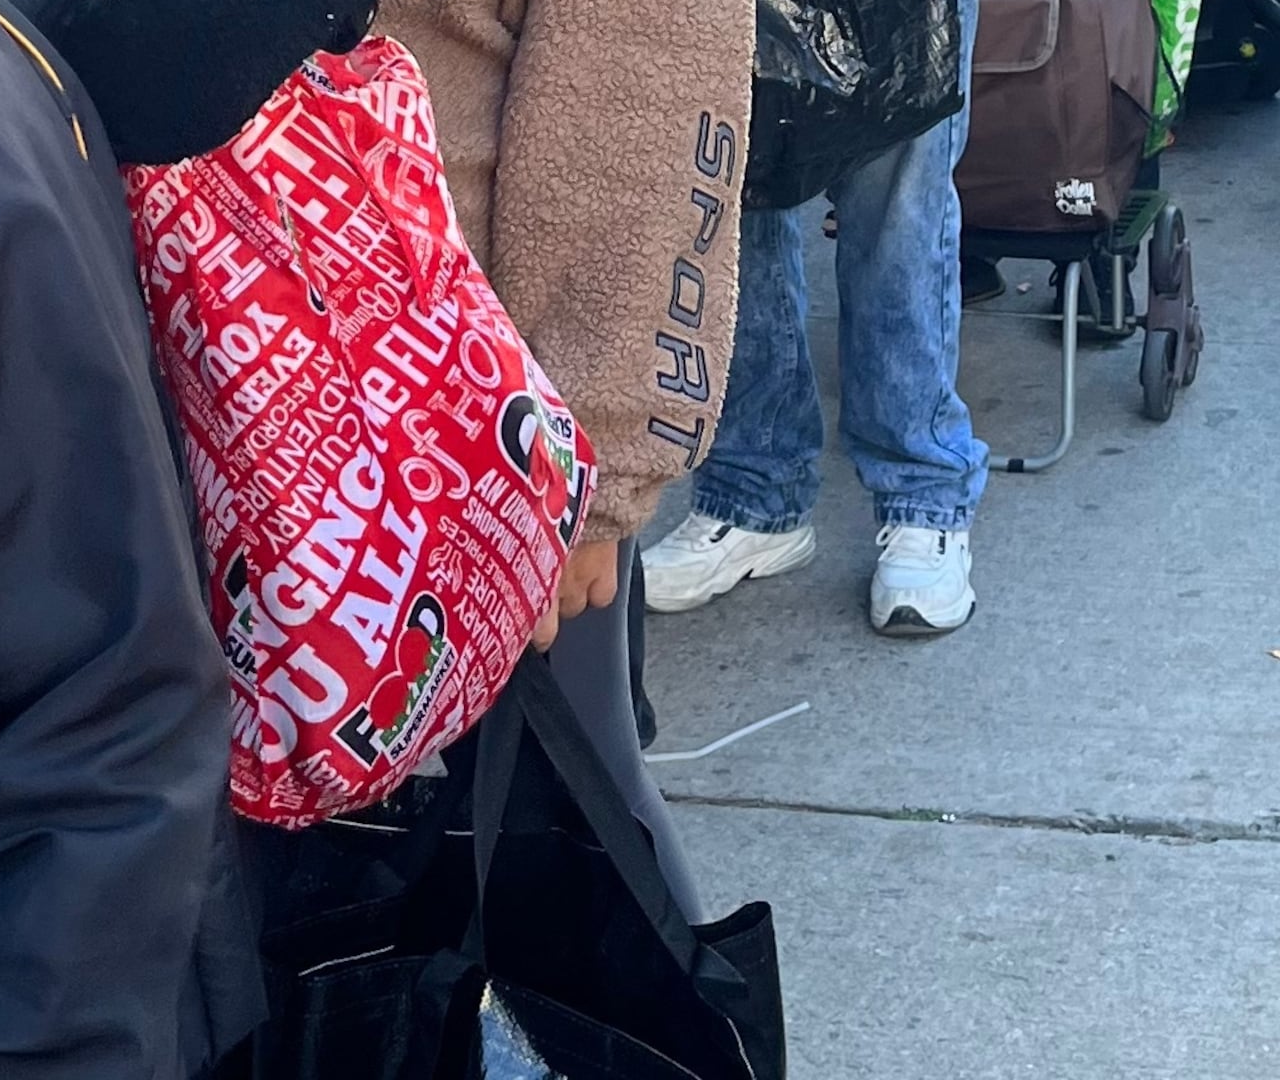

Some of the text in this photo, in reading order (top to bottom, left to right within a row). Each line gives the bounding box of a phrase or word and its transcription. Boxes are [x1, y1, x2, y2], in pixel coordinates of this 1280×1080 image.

[647, 110, 736, 471] SPORT
[234, 360, 353, 523] ADVENTURE
[261, 412, 361, 555] CULINARY
[473, 467, 509, 508] AN
[330, 499, 429, 668] ALL
[436, 514, 486, 565] PRICES
[462, 496, 520, 564] SHOPPING
[389, 648, 456, 761] SUPERMARKET
